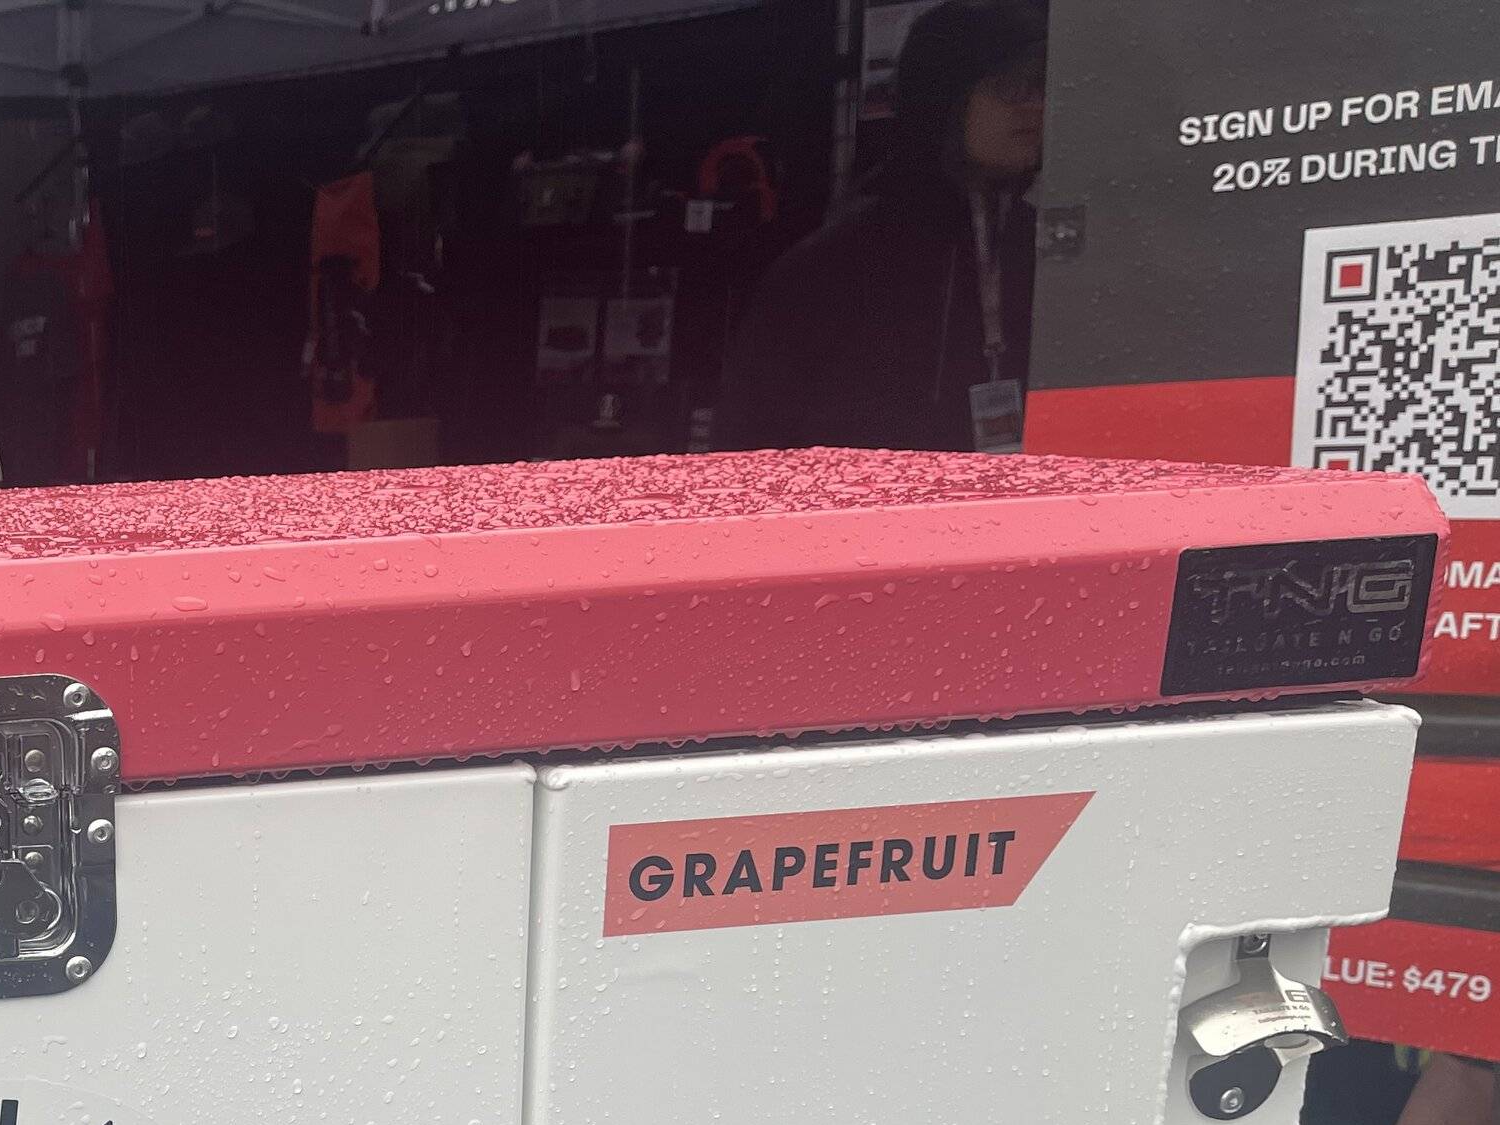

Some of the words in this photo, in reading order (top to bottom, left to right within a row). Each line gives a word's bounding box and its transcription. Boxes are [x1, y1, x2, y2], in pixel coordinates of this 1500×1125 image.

[1178, 107, 1274, 146] SIGN
[1282, 100, 1333, 134] UP
[1341, 90, 1421, 127] FOR
[1430, 80, 1500, 116] EM
[1212, 157, 1292, 193] 20%
[1300, 139, 1457, 184] DURING
[1469, 134, 1500, 166] T
[1443, 560, 1500, 590] MA
[628, 830, 1015, 902] GRAPEFRUIT
[1401, 964, 1493, 1003] $479
